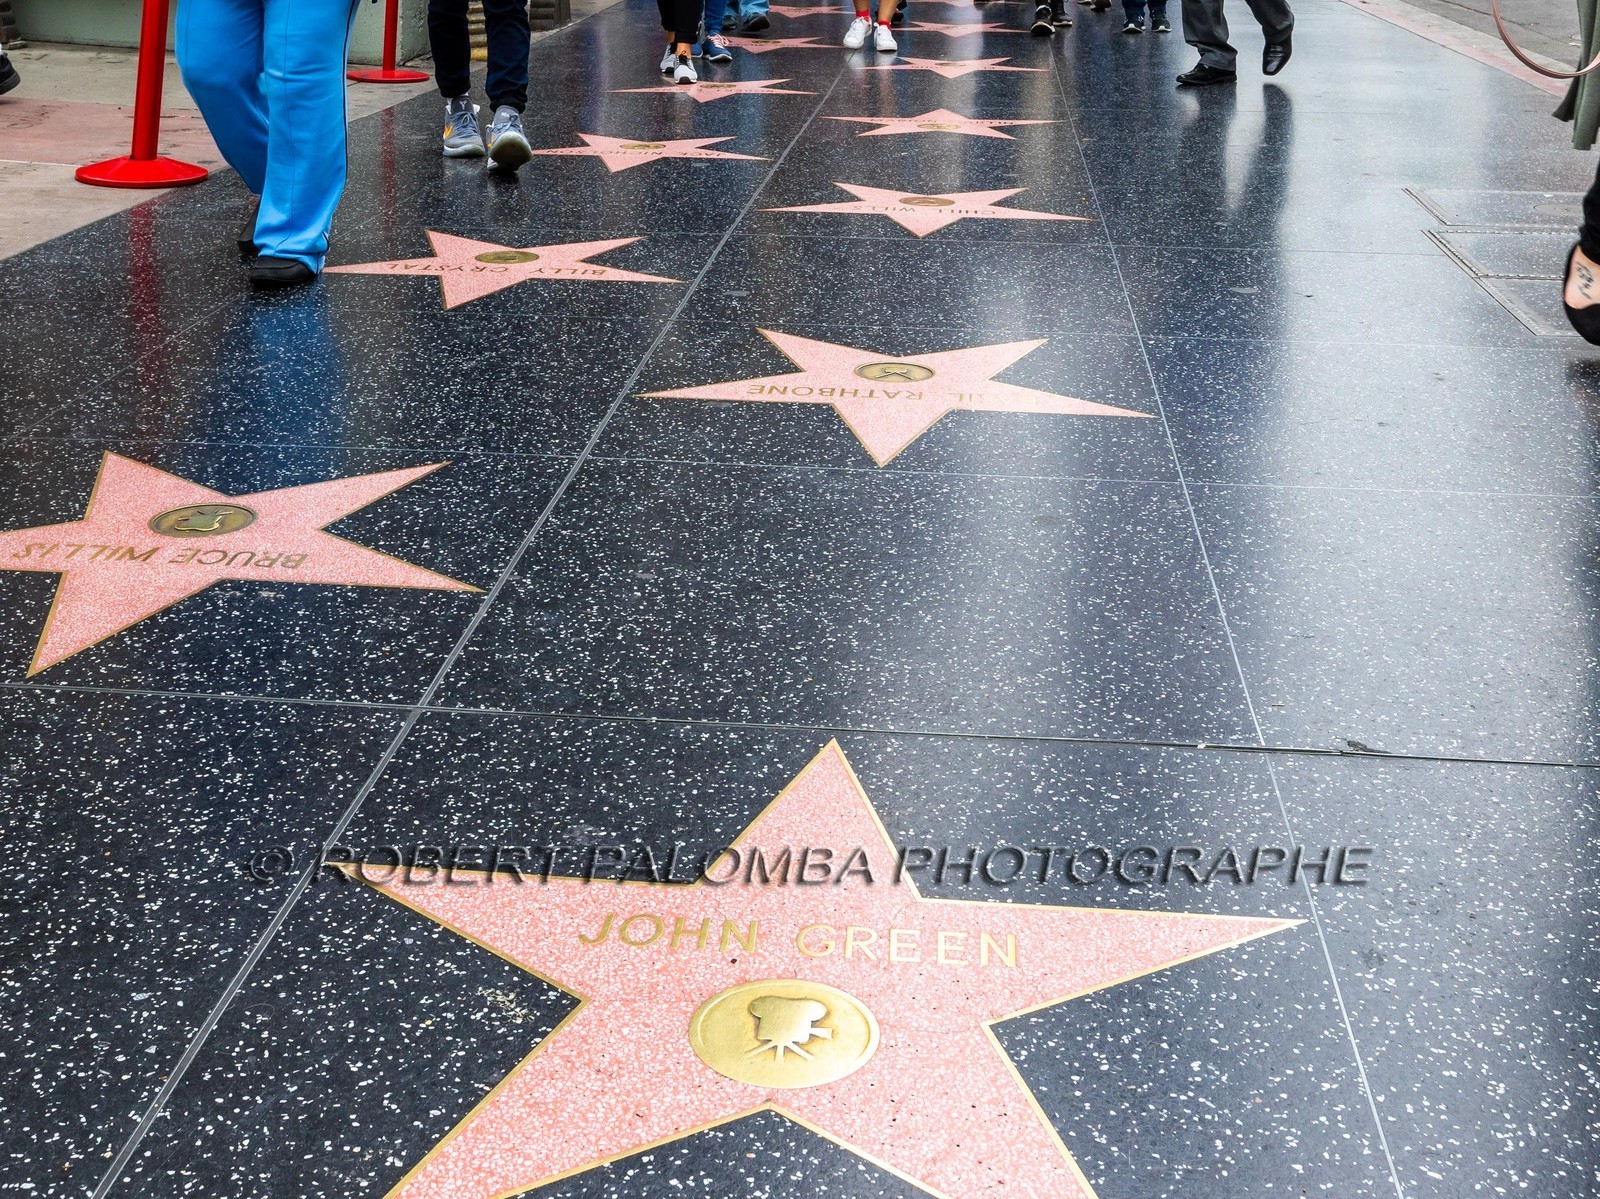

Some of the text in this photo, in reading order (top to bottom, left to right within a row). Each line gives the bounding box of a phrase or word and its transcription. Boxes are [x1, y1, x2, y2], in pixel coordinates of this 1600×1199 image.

[384, 263, 607, 276] BILLY CRYSTAL
[746, 383, 924, 400] RATHBONE
[12, 542, 311, 569] BRUCE WILLIS
[578, 913, 1018, 968] JOHN GREEN
